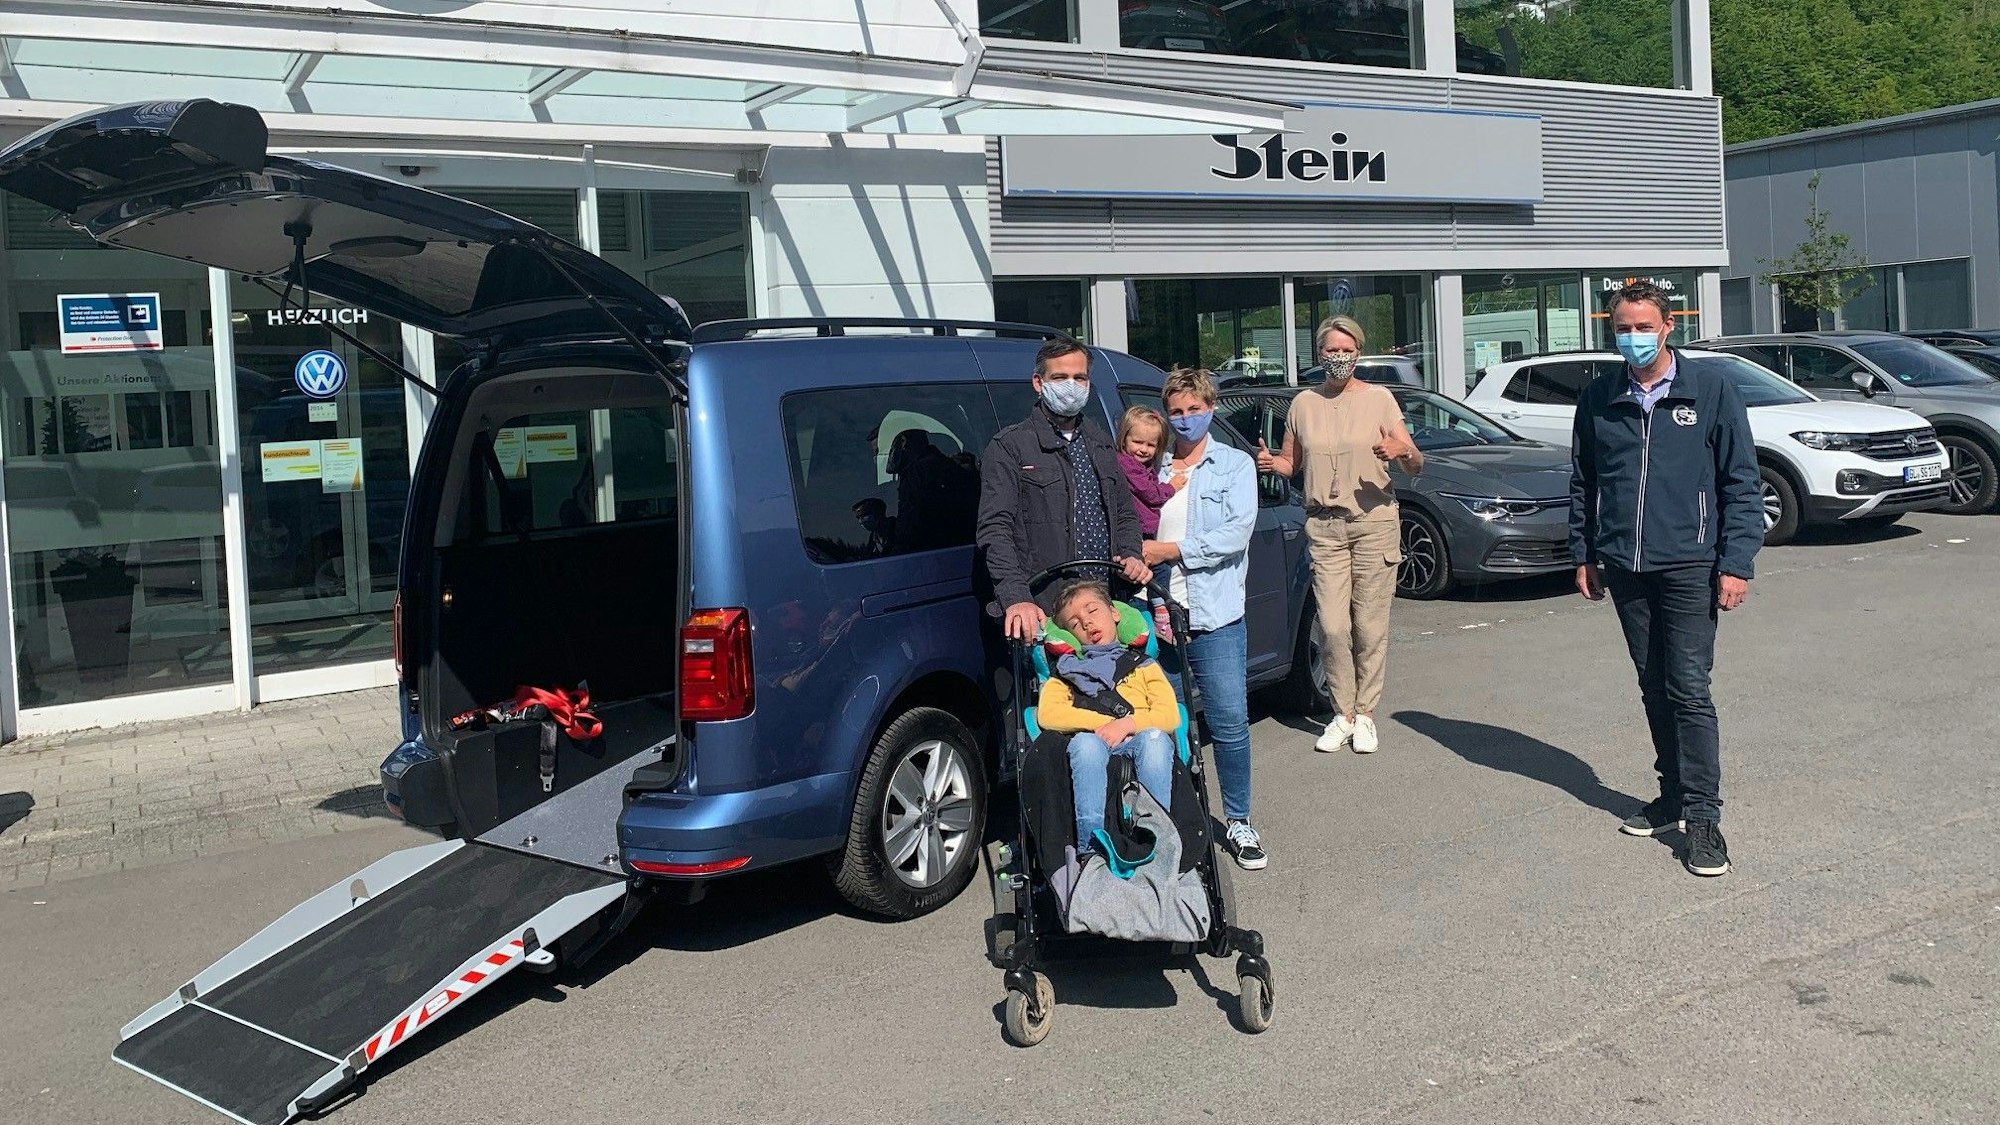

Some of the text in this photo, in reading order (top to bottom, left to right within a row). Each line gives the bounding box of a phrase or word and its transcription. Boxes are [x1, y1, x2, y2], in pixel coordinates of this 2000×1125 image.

[1209, 131, 1387, 184] Stein
[1603, 277, 1623, 291] Das
[57, 376, 99, 385] Unsere
